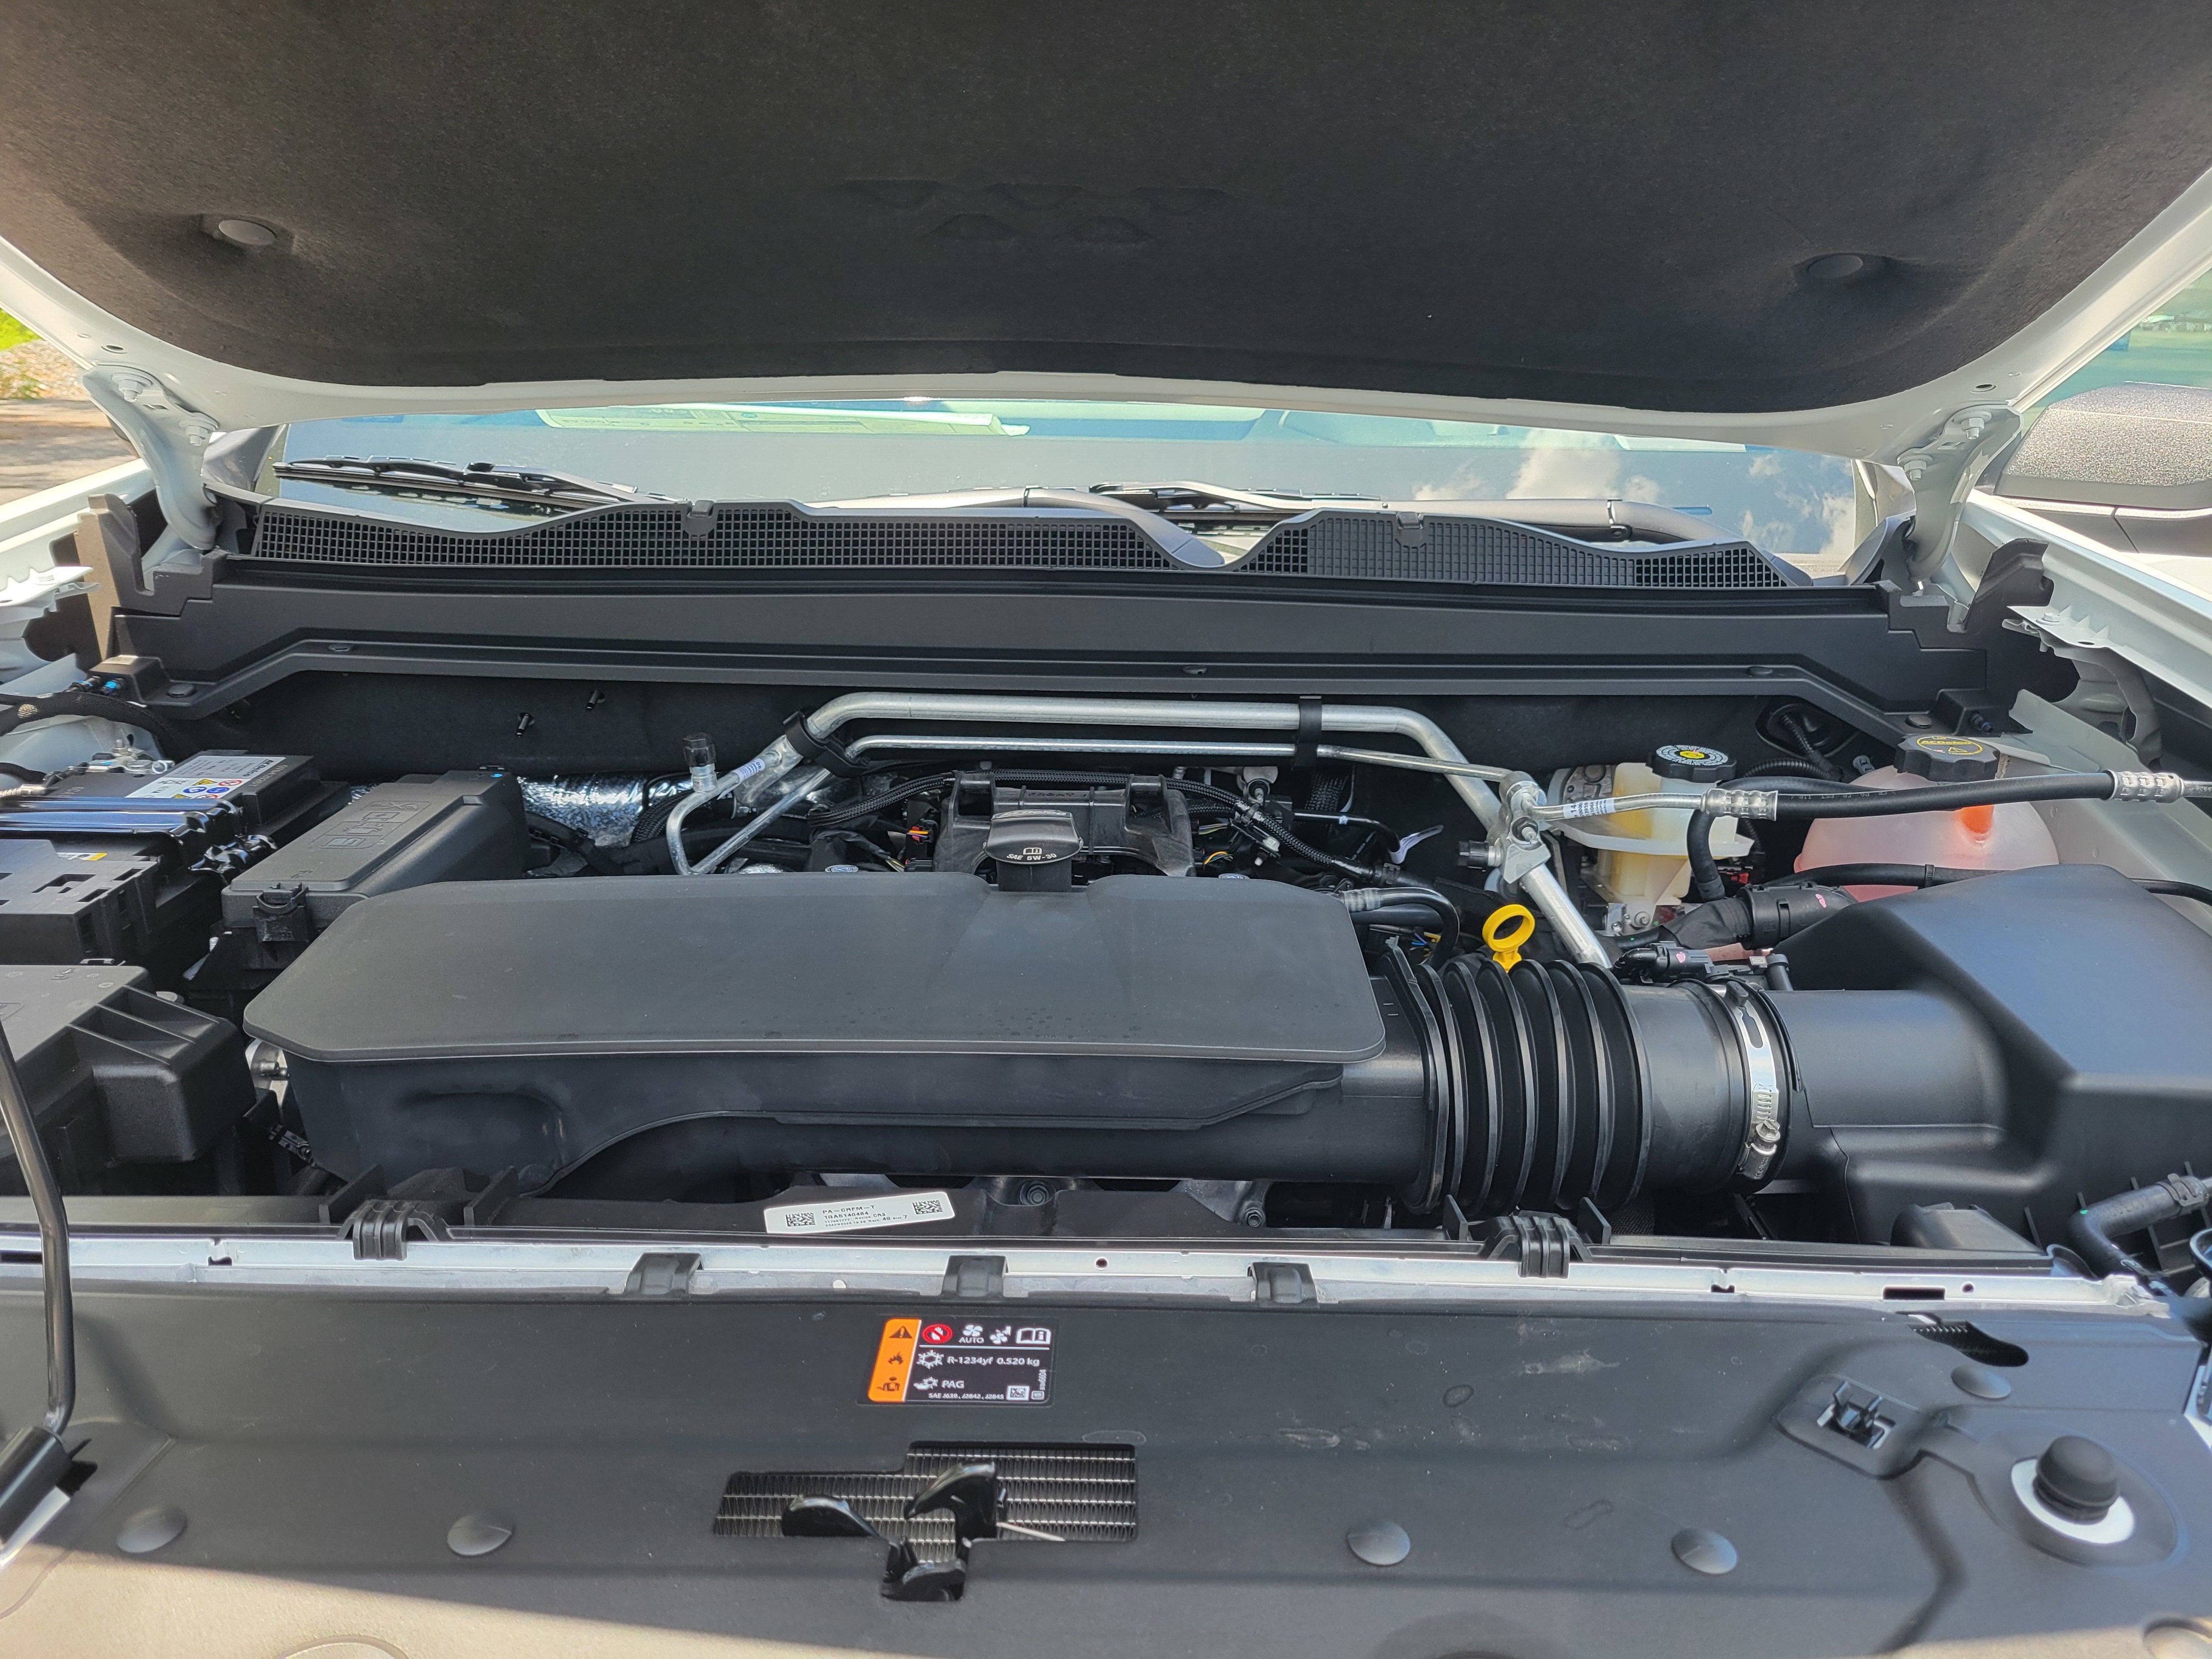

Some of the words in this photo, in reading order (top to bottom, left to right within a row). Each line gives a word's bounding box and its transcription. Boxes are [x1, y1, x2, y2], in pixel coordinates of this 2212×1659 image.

[946, 1357, 994, 1366] R-1234yf
[996, 1357, 1025, 1365] 0.520
[1026, 1358, 1040, 1367] kg
[941, 1380, 965, 1389] PAG
